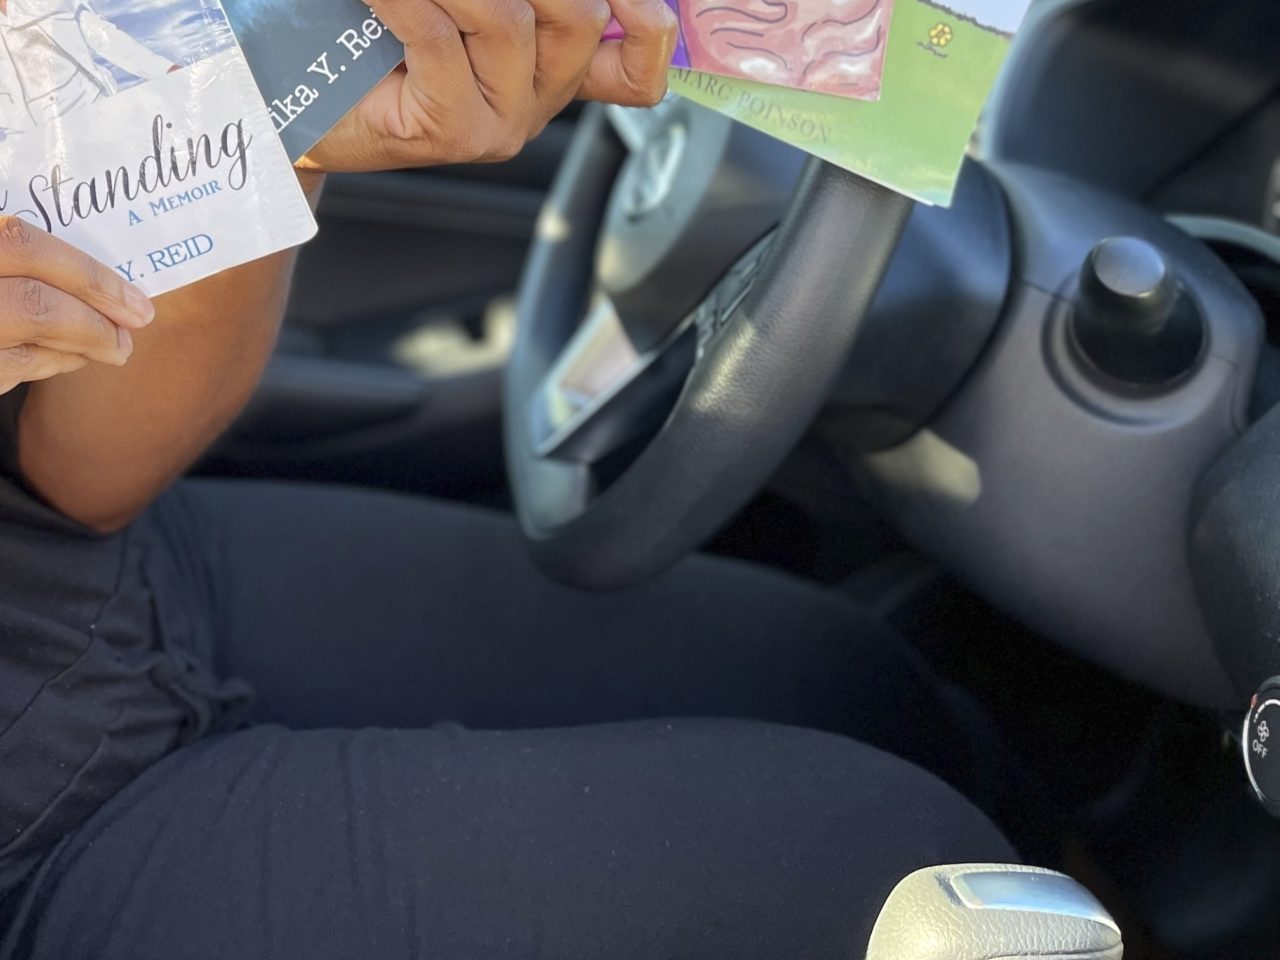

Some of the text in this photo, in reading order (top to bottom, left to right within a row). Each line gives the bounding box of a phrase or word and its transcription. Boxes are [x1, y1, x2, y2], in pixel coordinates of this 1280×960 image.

[306, 51, 346, 84] Y.
[336, 7, 388, 60] Re
[737, 90, 833, 145] POINSON
[12, 114, 254, 234] Standing
[128, 180, 223, 227] A MEMOIR
[115, 233, 214, 283] Y. REID
[1253, 738, 1268, 759] OFF
